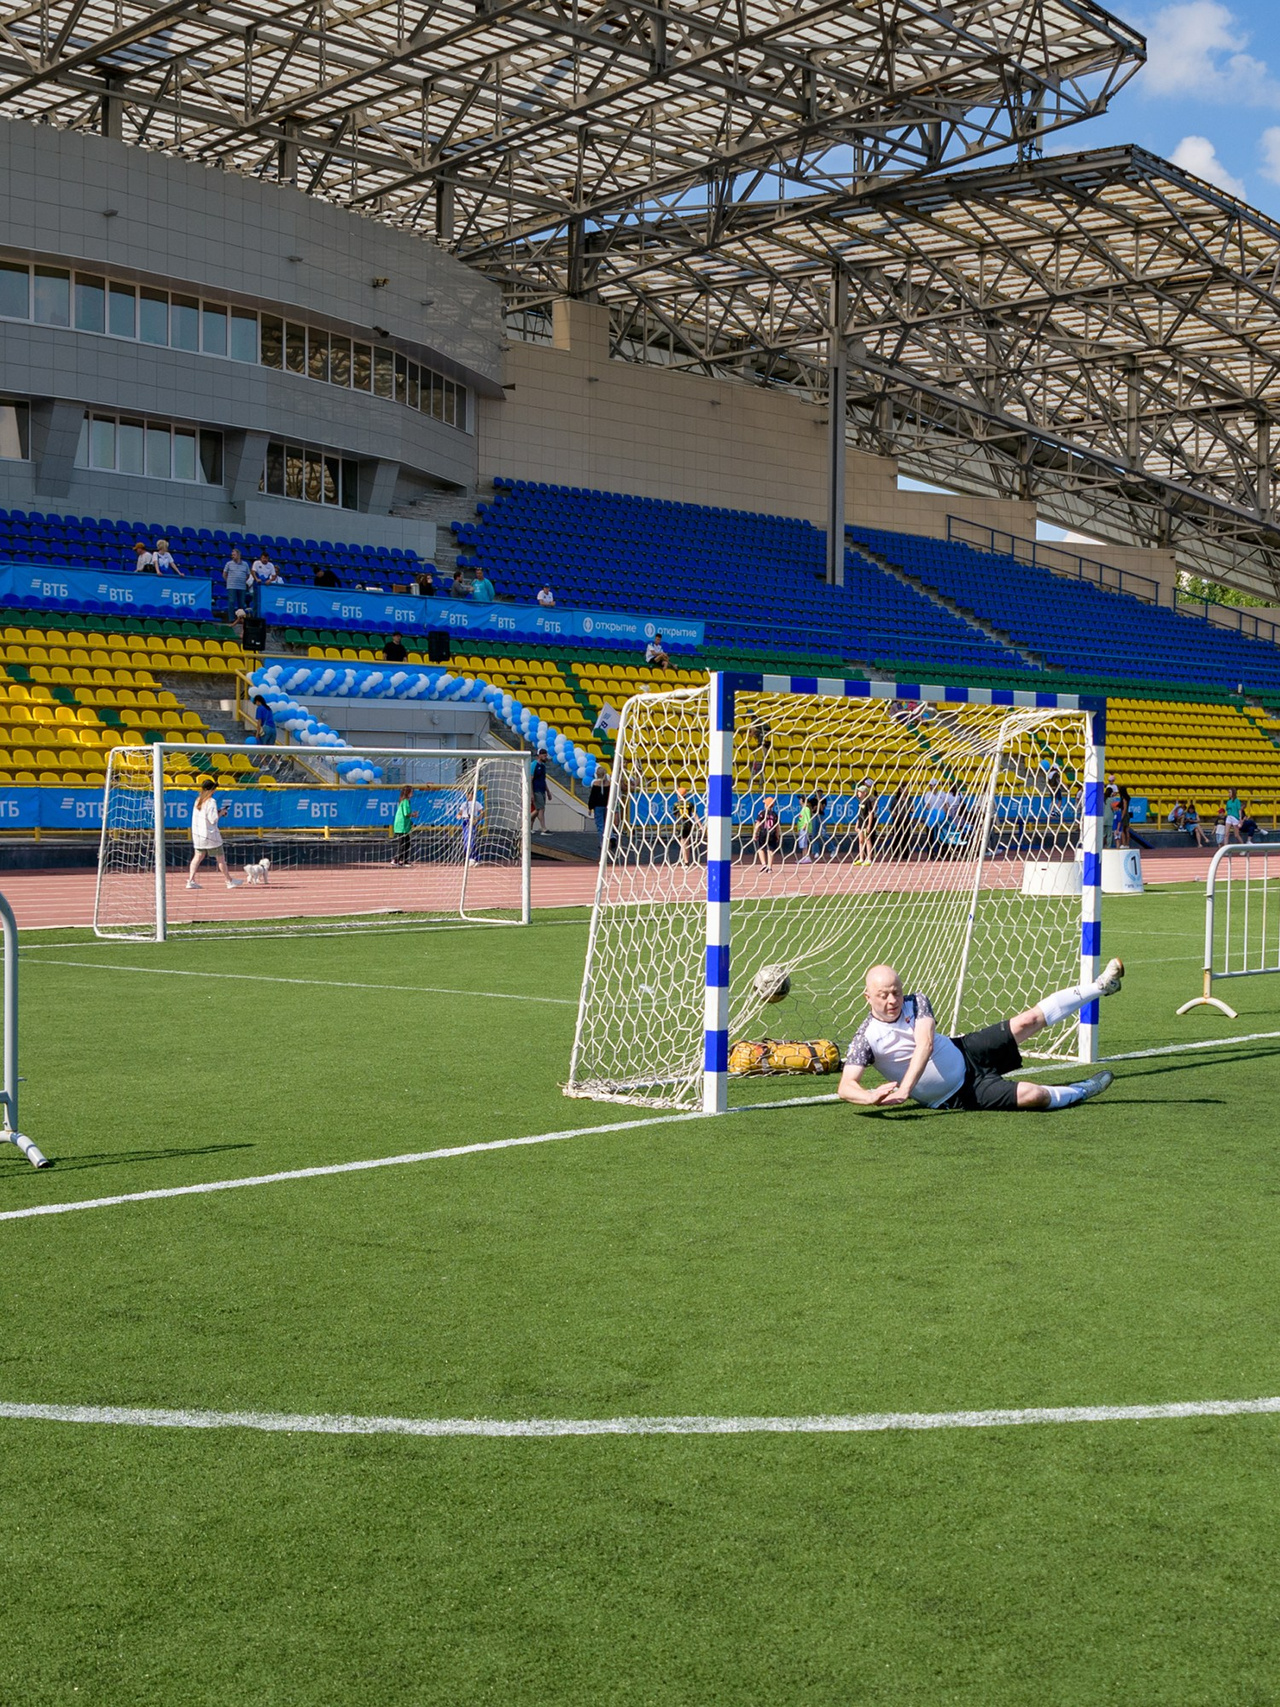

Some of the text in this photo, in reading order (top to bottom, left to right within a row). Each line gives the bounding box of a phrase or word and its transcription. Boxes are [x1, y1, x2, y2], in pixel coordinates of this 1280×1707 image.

[42, 582, 69, 597] ВТБ
[109, 588, 134, 602] ВТБ
[172, 592, 196, 606] ВТБ
[286, 601, 308, 615] ВТБ
[342, 605, 363, 619] ВТБ
[395, 609, 416, 622] ВТБ
[449, 613, 468, 626] ВТБ
[498, 617, 516, 630] ВТБ
[544, 621, 561, 633] ВТБ
[595, 621, 637, 633] открытие
[657, 626, 697, 638] открытие
[0, 801, 20, 818] ТБ
[163, 802, 189, 818] ТБ
[233, 802, 264, 818] ВТБ
[311, 802, 338, 818] ВТБ
[379, 802, 399, 817] ВТ
[1130, 856, 1138, 875] 1
